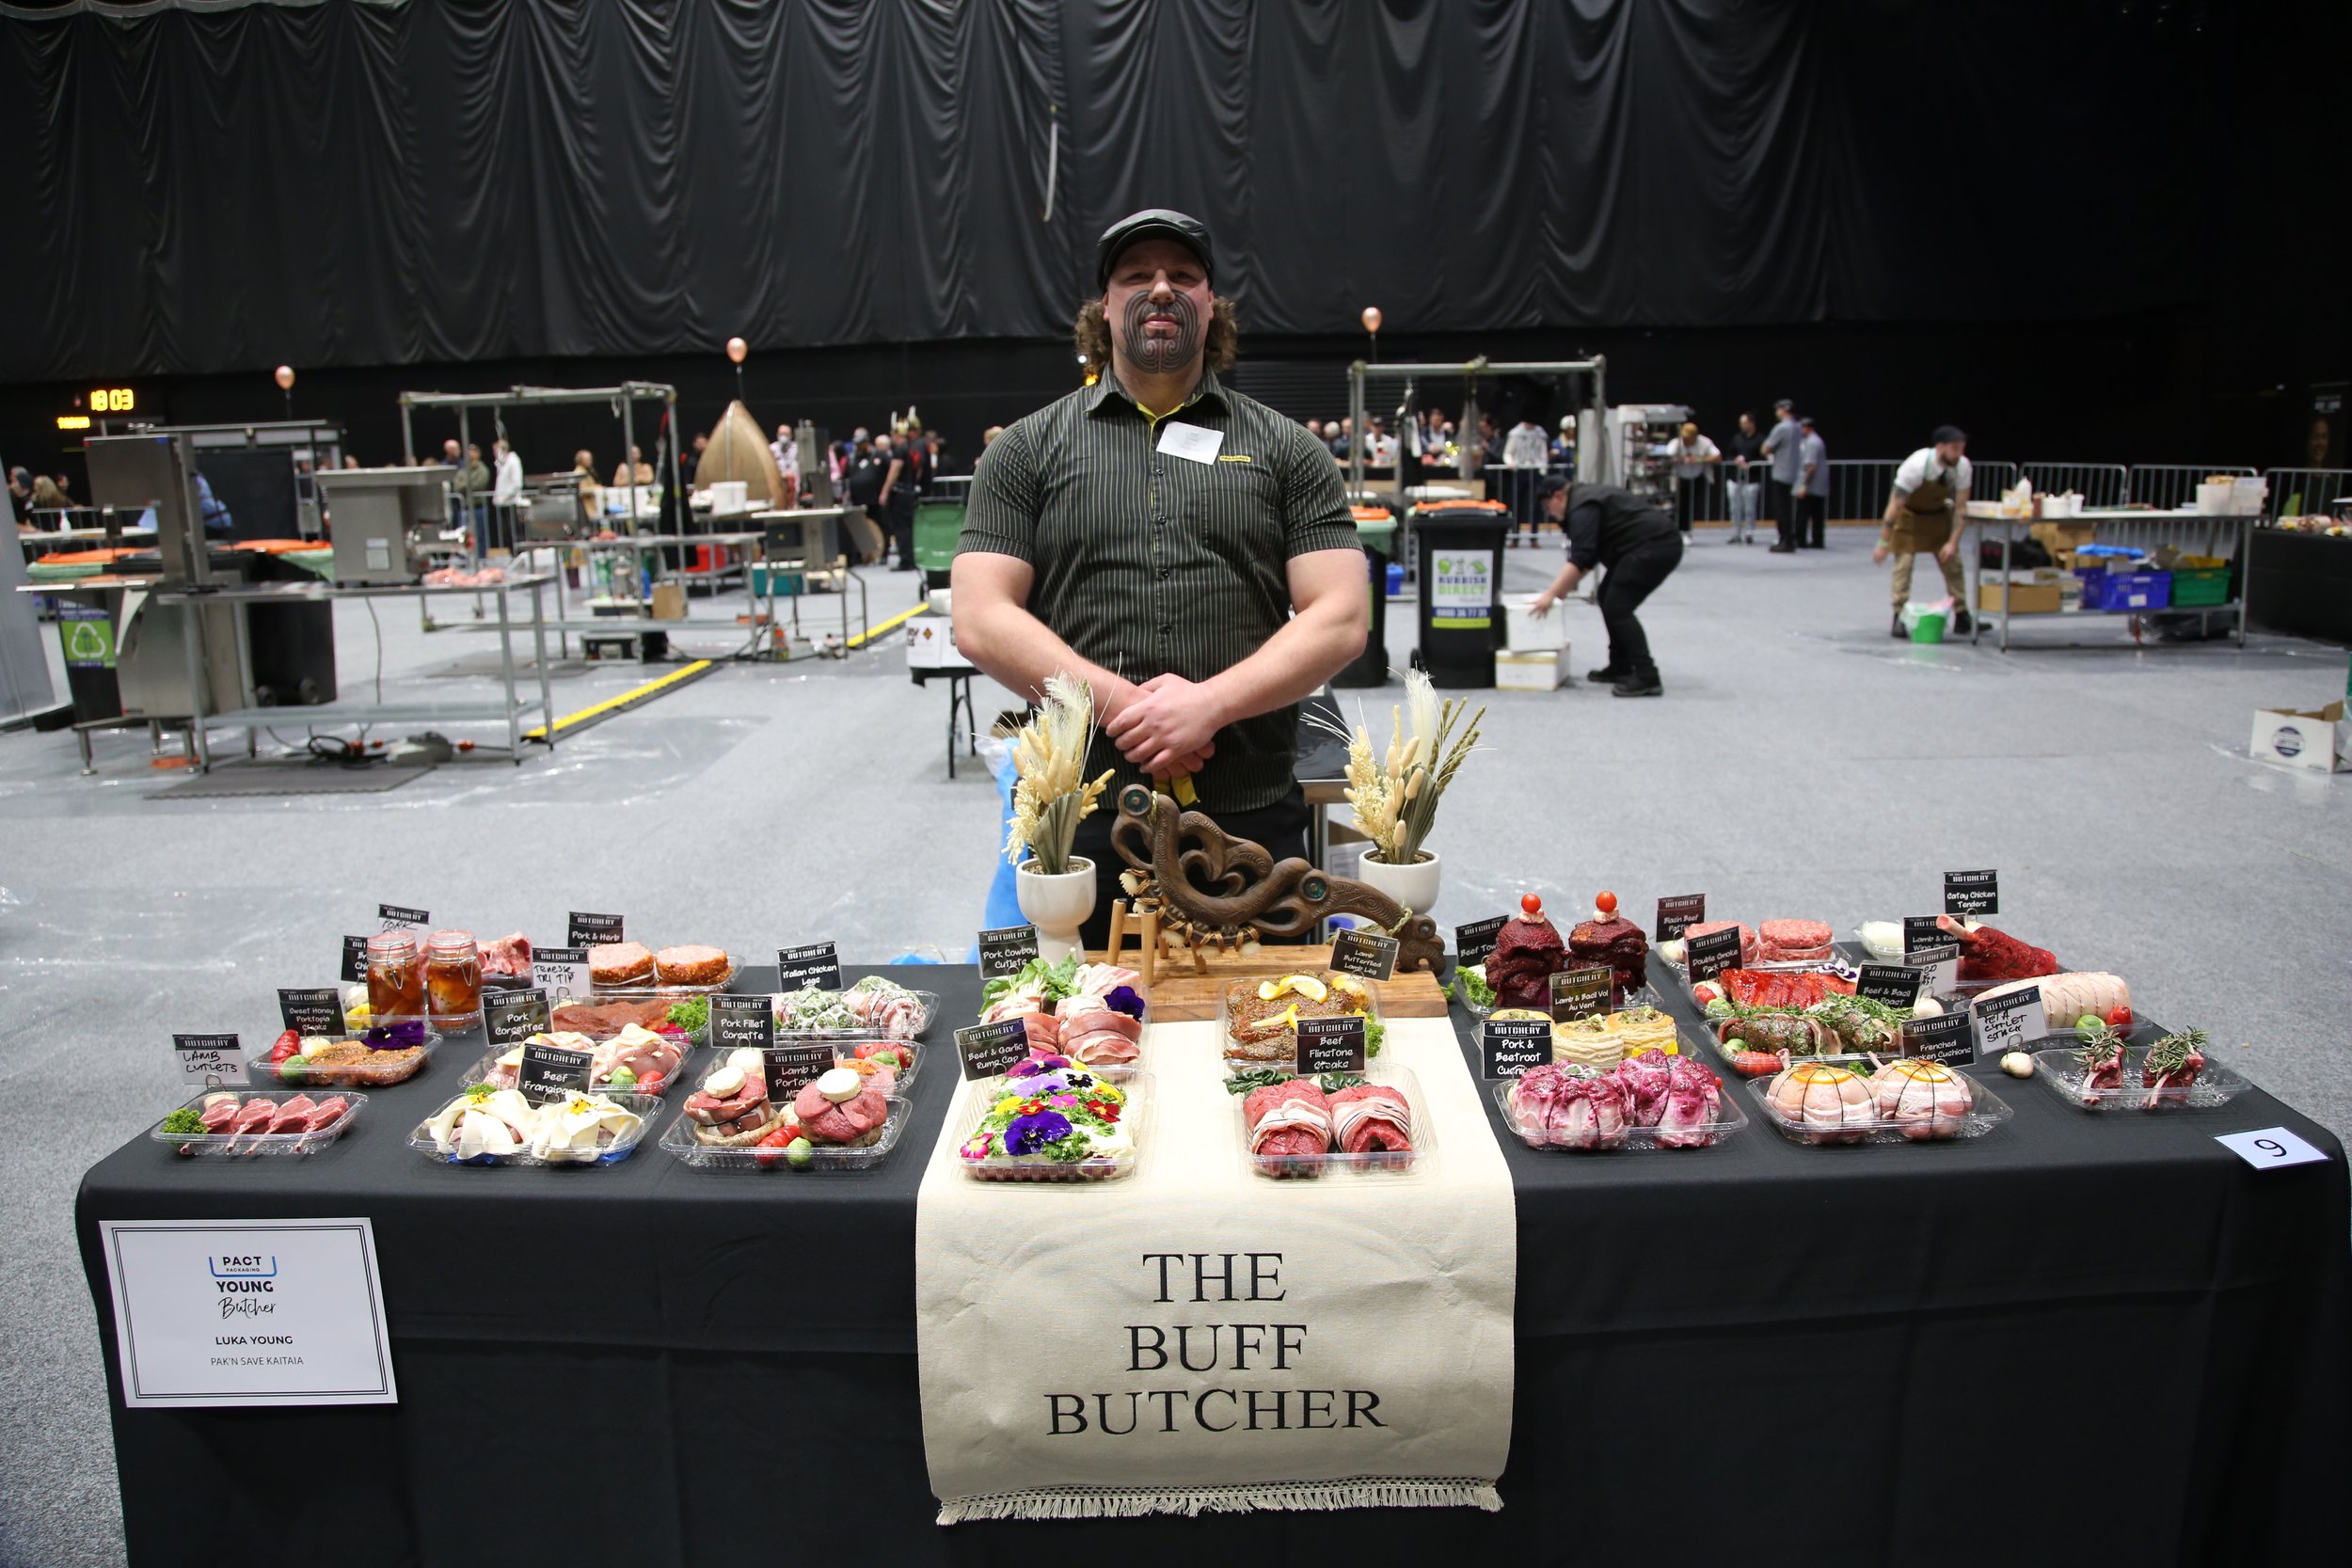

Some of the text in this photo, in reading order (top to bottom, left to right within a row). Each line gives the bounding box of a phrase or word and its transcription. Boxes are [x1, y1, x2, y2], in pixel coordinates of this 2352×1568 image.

[1438, 585, 1486, 594] DIRECT
[572, 930, 620, 942] Pork & Herb
[983, 947, 1037, 959] Pork Cowboy
[1355, 950, 1375, 958] Lamb
[1460, 946, 1479, 958] Beef
[808, 965, 837, 974] Chicken
[1555, 996, 1574, 1005] Lamb
[1580, 1001, 1597, 1009] Vent
[506, 1012, 530, 1022] Pork
[721, 1018, 765, 1029] Pork Fillet
[1309, 1023, 1354, 1034] BUTCHERY
[1495, 1026, 1541, 1035] BUTCHERY
[1319, 1036, 1343, 1046] Beef
[1502, 1038, 1534, 1050] Pork &
[1920, 1039, 1957, 1052] Frenched
[183, 1050, 221, 1063] LAMB
[968, 1049, 989, 1061] Beef
[998, 1043, 1024, 1054] Garlic
[1309, 1048, 1354, 1058] Flinstone
[1495, 1052, 1542, 1063] Beetroot
[1938, 1047, 1972, 1058] Cushions
[534, 1051, 582, 1065] BUTCHERY
[1001, 1055, 1019, 1064] Cap
[781, 1064, 818, 1075] Lamb &
[542, 1070, 568, 1083] Beef
[2253, 1138, 2287, 1158] 9
[222, 1256, 262, 1266] PACT
[1142, 1253, 1286, 1303] THE
[216, 1280, 274, 1293] YOUNG
[217, 1296, 277, 1320] Butcher
[215, 1336, 294, 1346] LUKA YOUNG
[1123, 1323, 1308, 1372] BUFF
[211, 1355, 304, 1367] PAK'N SAVE KAITAIA
[1043, 1388, 1389, 1435] BUTCHER
